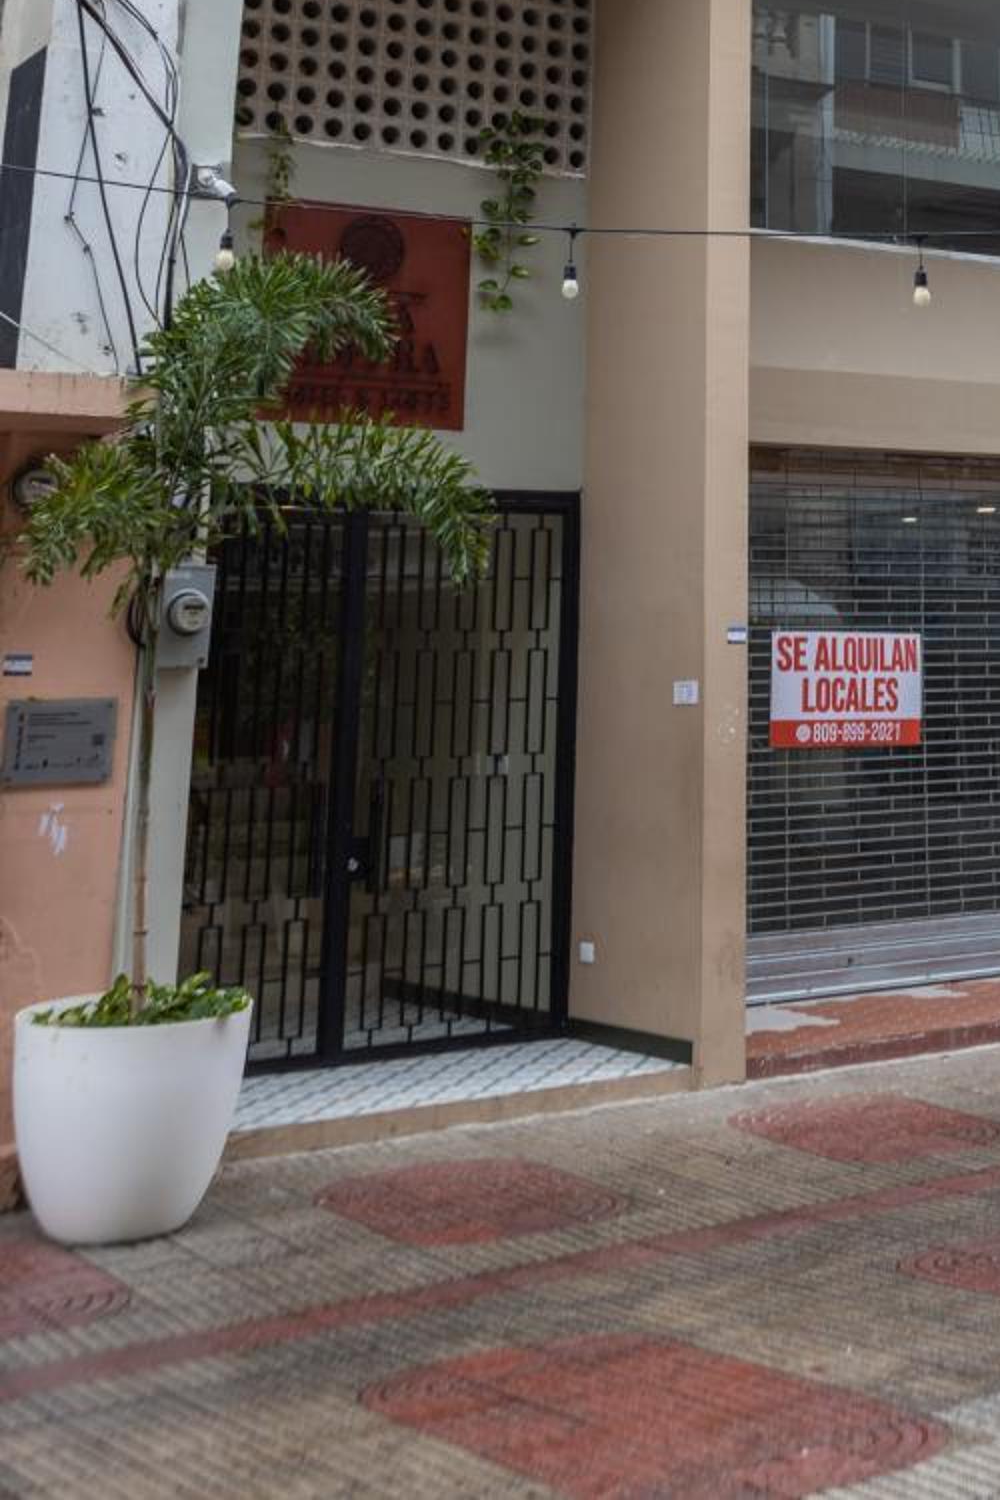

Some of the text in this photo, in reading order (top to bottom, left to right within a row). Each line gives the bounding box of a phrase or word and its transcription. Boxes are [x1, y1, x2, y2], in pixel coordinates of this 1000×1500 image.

[776, 636, 918, 673] SE ALQUILAN
[801, 677, 898, 713] LOCALES
